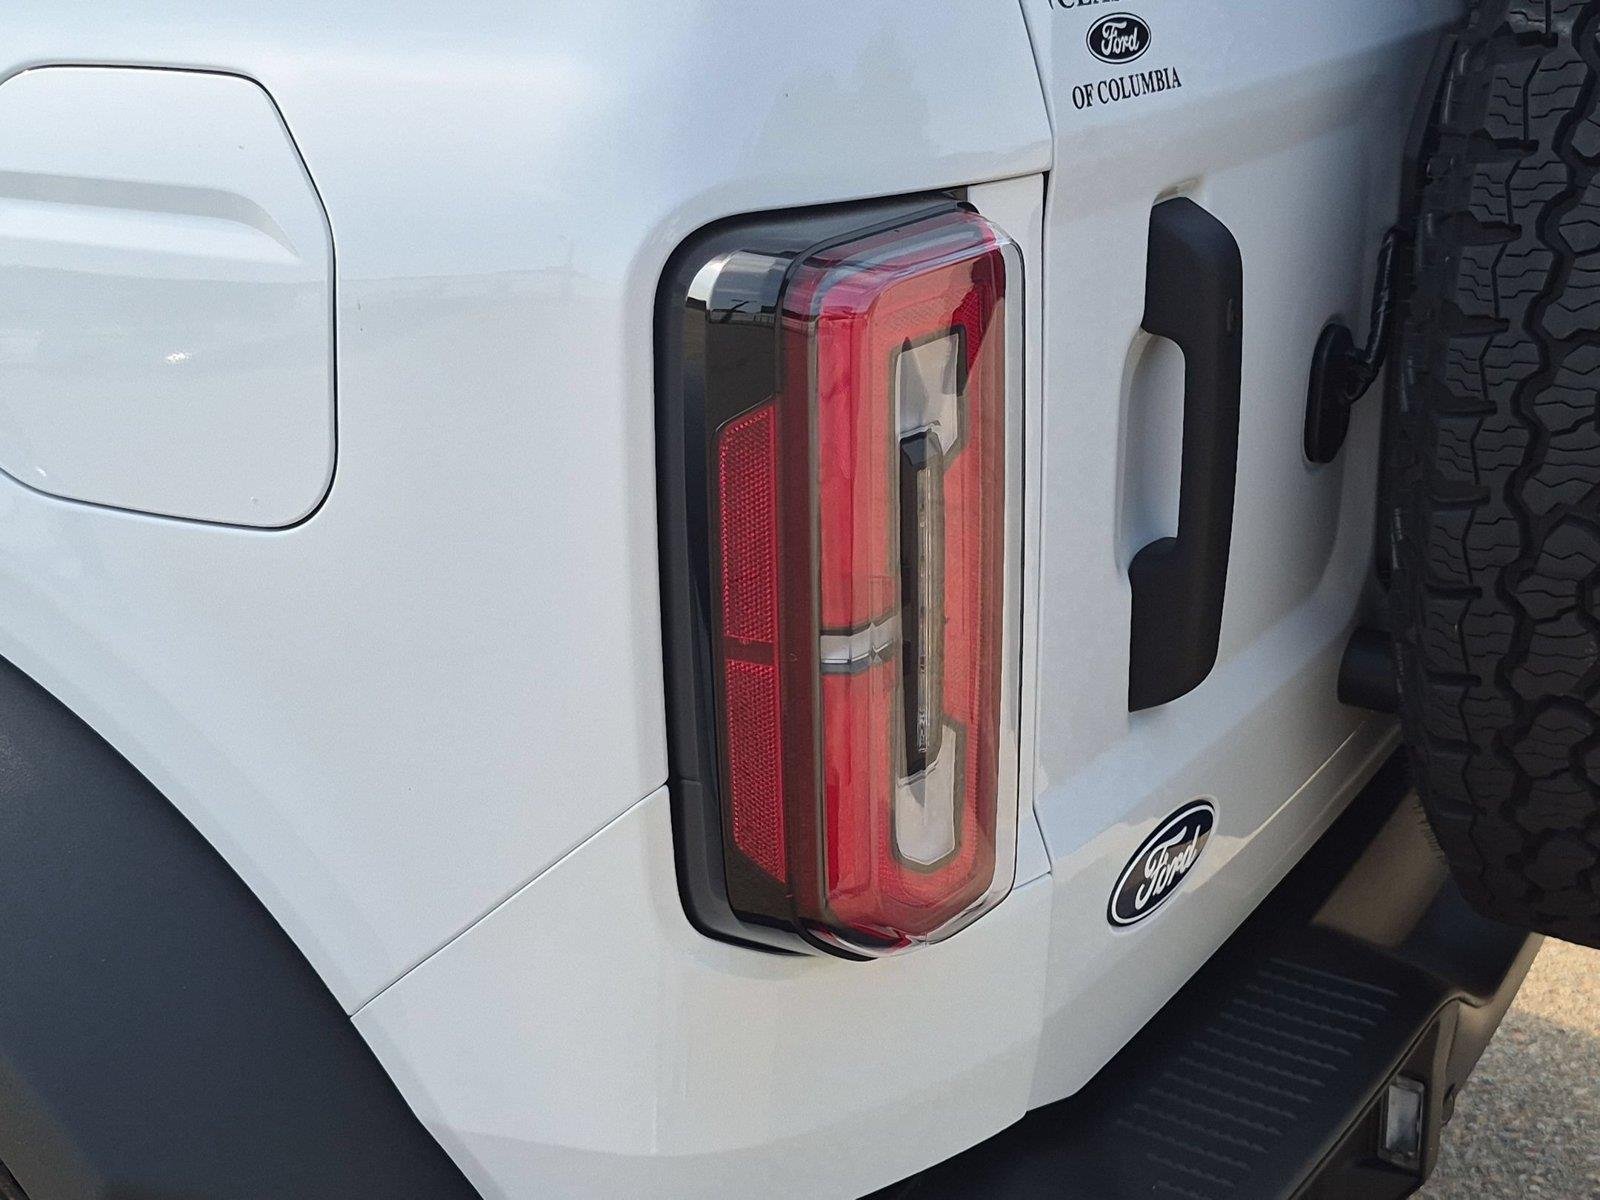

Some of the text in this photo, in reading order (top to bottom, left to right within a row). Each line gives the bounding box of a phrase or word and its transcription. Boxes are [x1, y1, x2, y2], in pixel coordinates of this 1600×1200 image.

[1101, 21, 1140, 56] Ford
[1072, 66, 1182, 110] OF COLUMBIA
[1134, 824, 1201, 911] Ford
